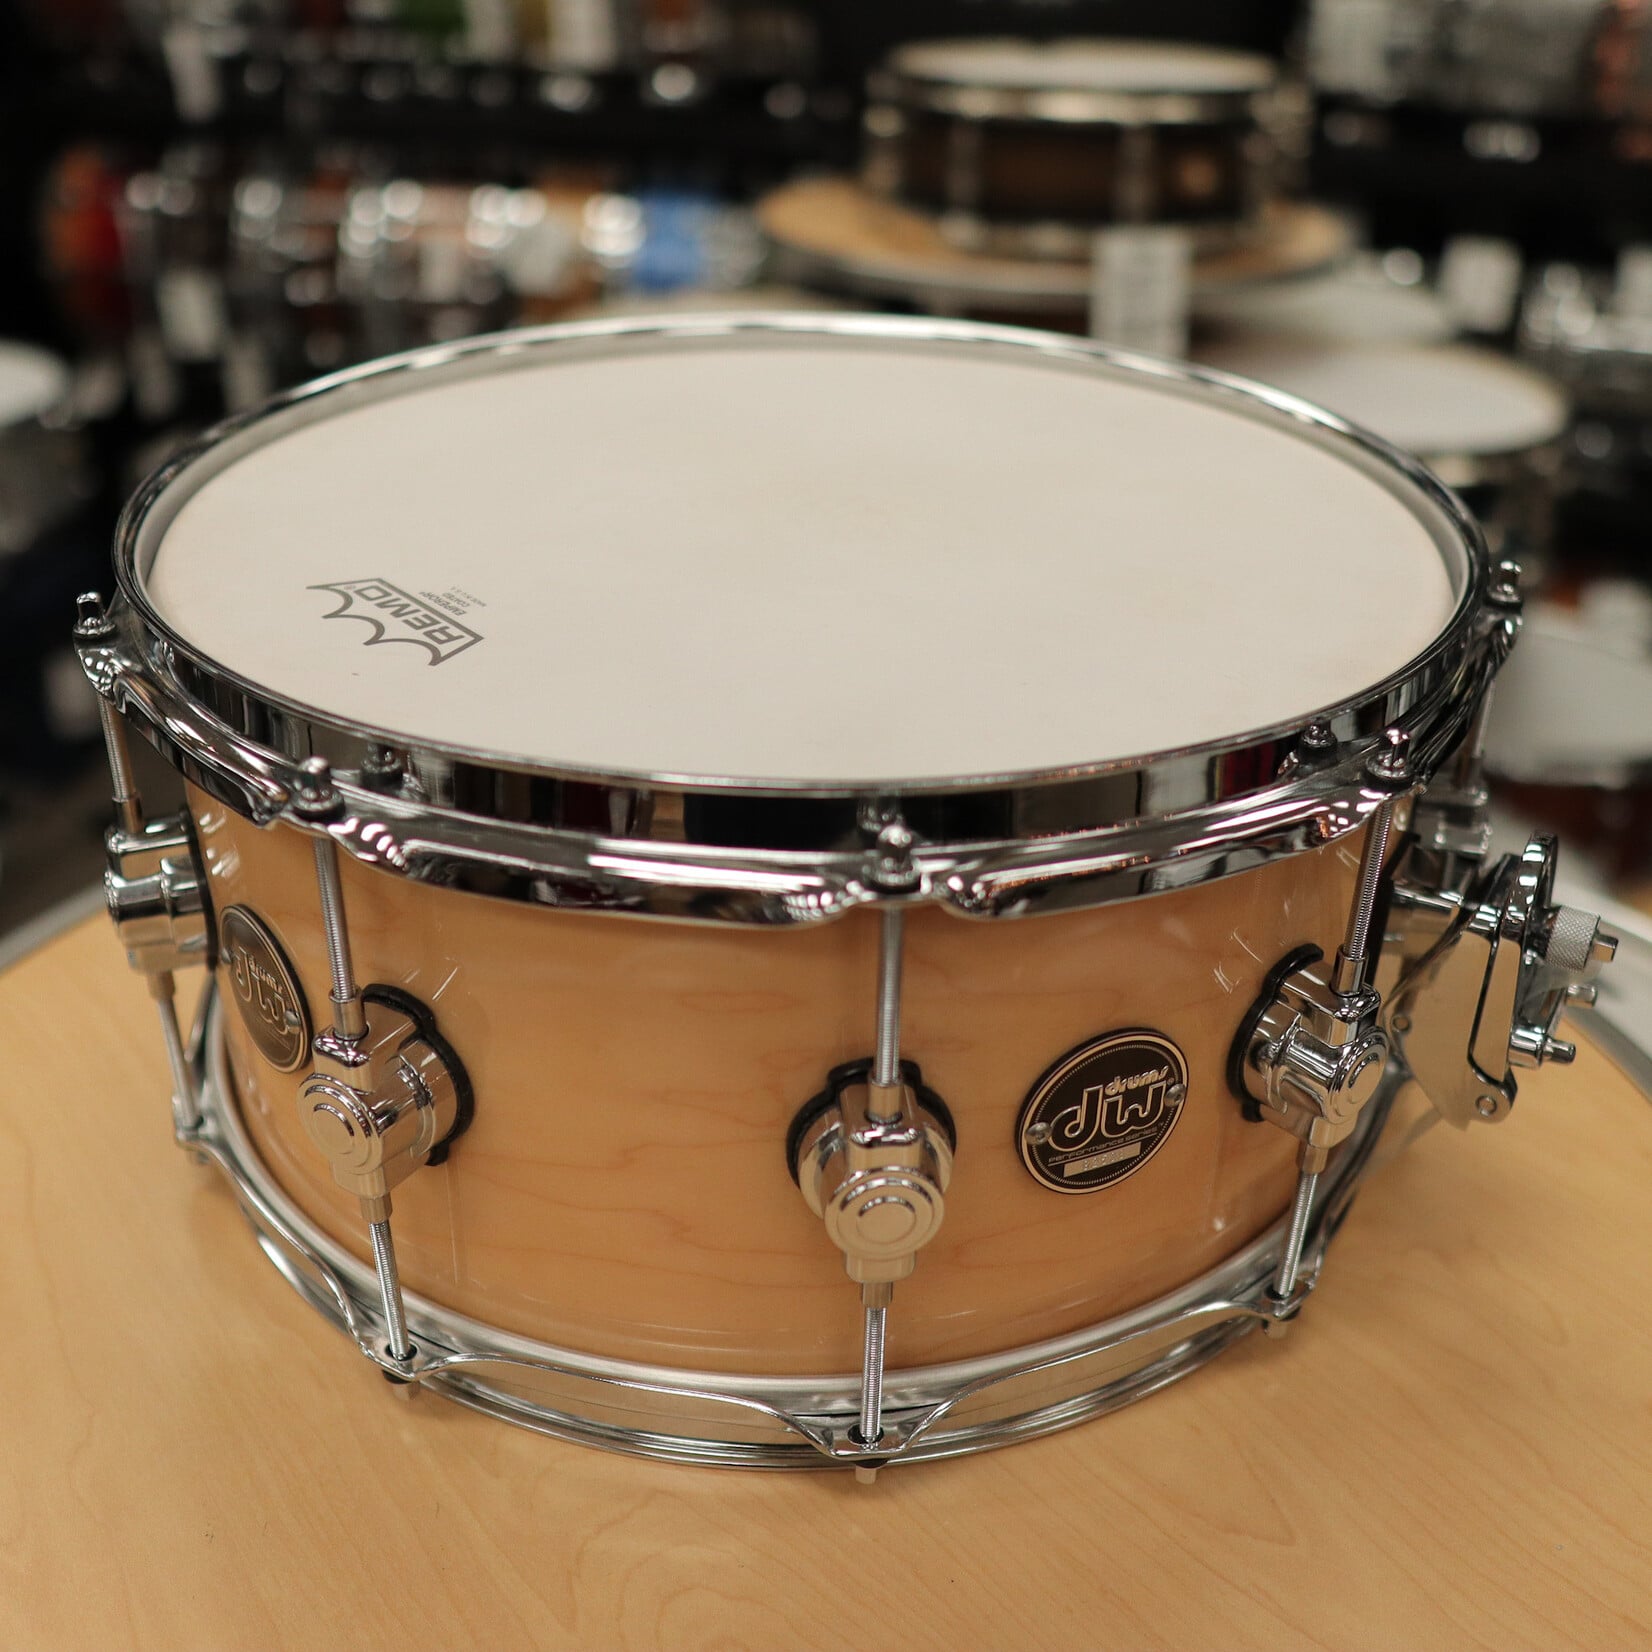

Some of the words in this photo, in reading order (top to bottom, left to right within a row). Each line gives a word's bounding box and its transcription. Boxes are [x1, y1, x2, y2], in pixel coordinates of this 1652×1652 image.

[353, 585, 465, 645] REMO
[1105, 1065, 1169, 1096] drums
[1048, 1080, 1167, 1152] dw
